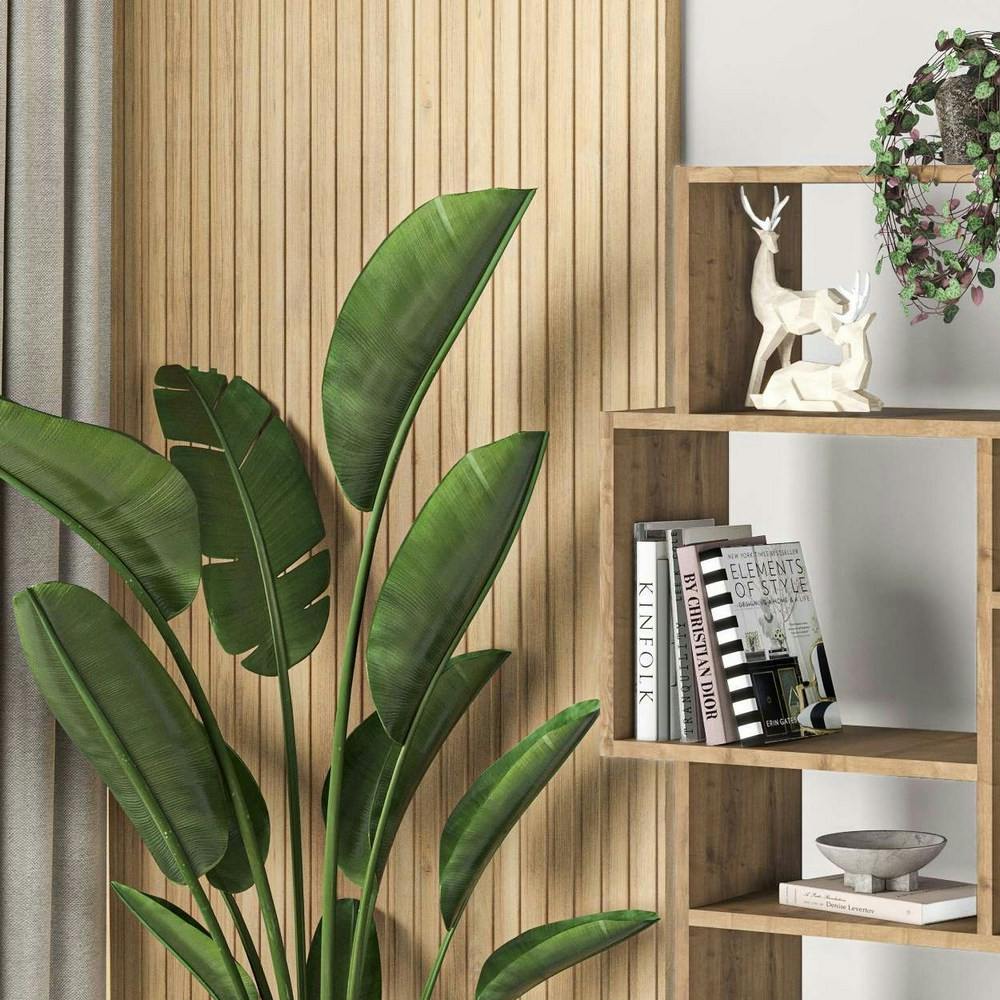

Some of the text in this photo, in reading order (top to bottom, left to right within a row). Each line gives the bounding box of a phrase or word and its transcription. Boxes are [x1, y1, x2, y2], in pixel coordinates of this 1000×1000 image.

[730, 558, 803, 580] ELEMENTS
[735, 576, 808, 598] OF STYLE
[639, 582, 654, 704] KINFOLK
[683, 572, 718, 720] BY CHRISTIAN DIOR
[676, 622, 694, 736] TRANQUILITY
[766, 719, 779, 727] ERIN
